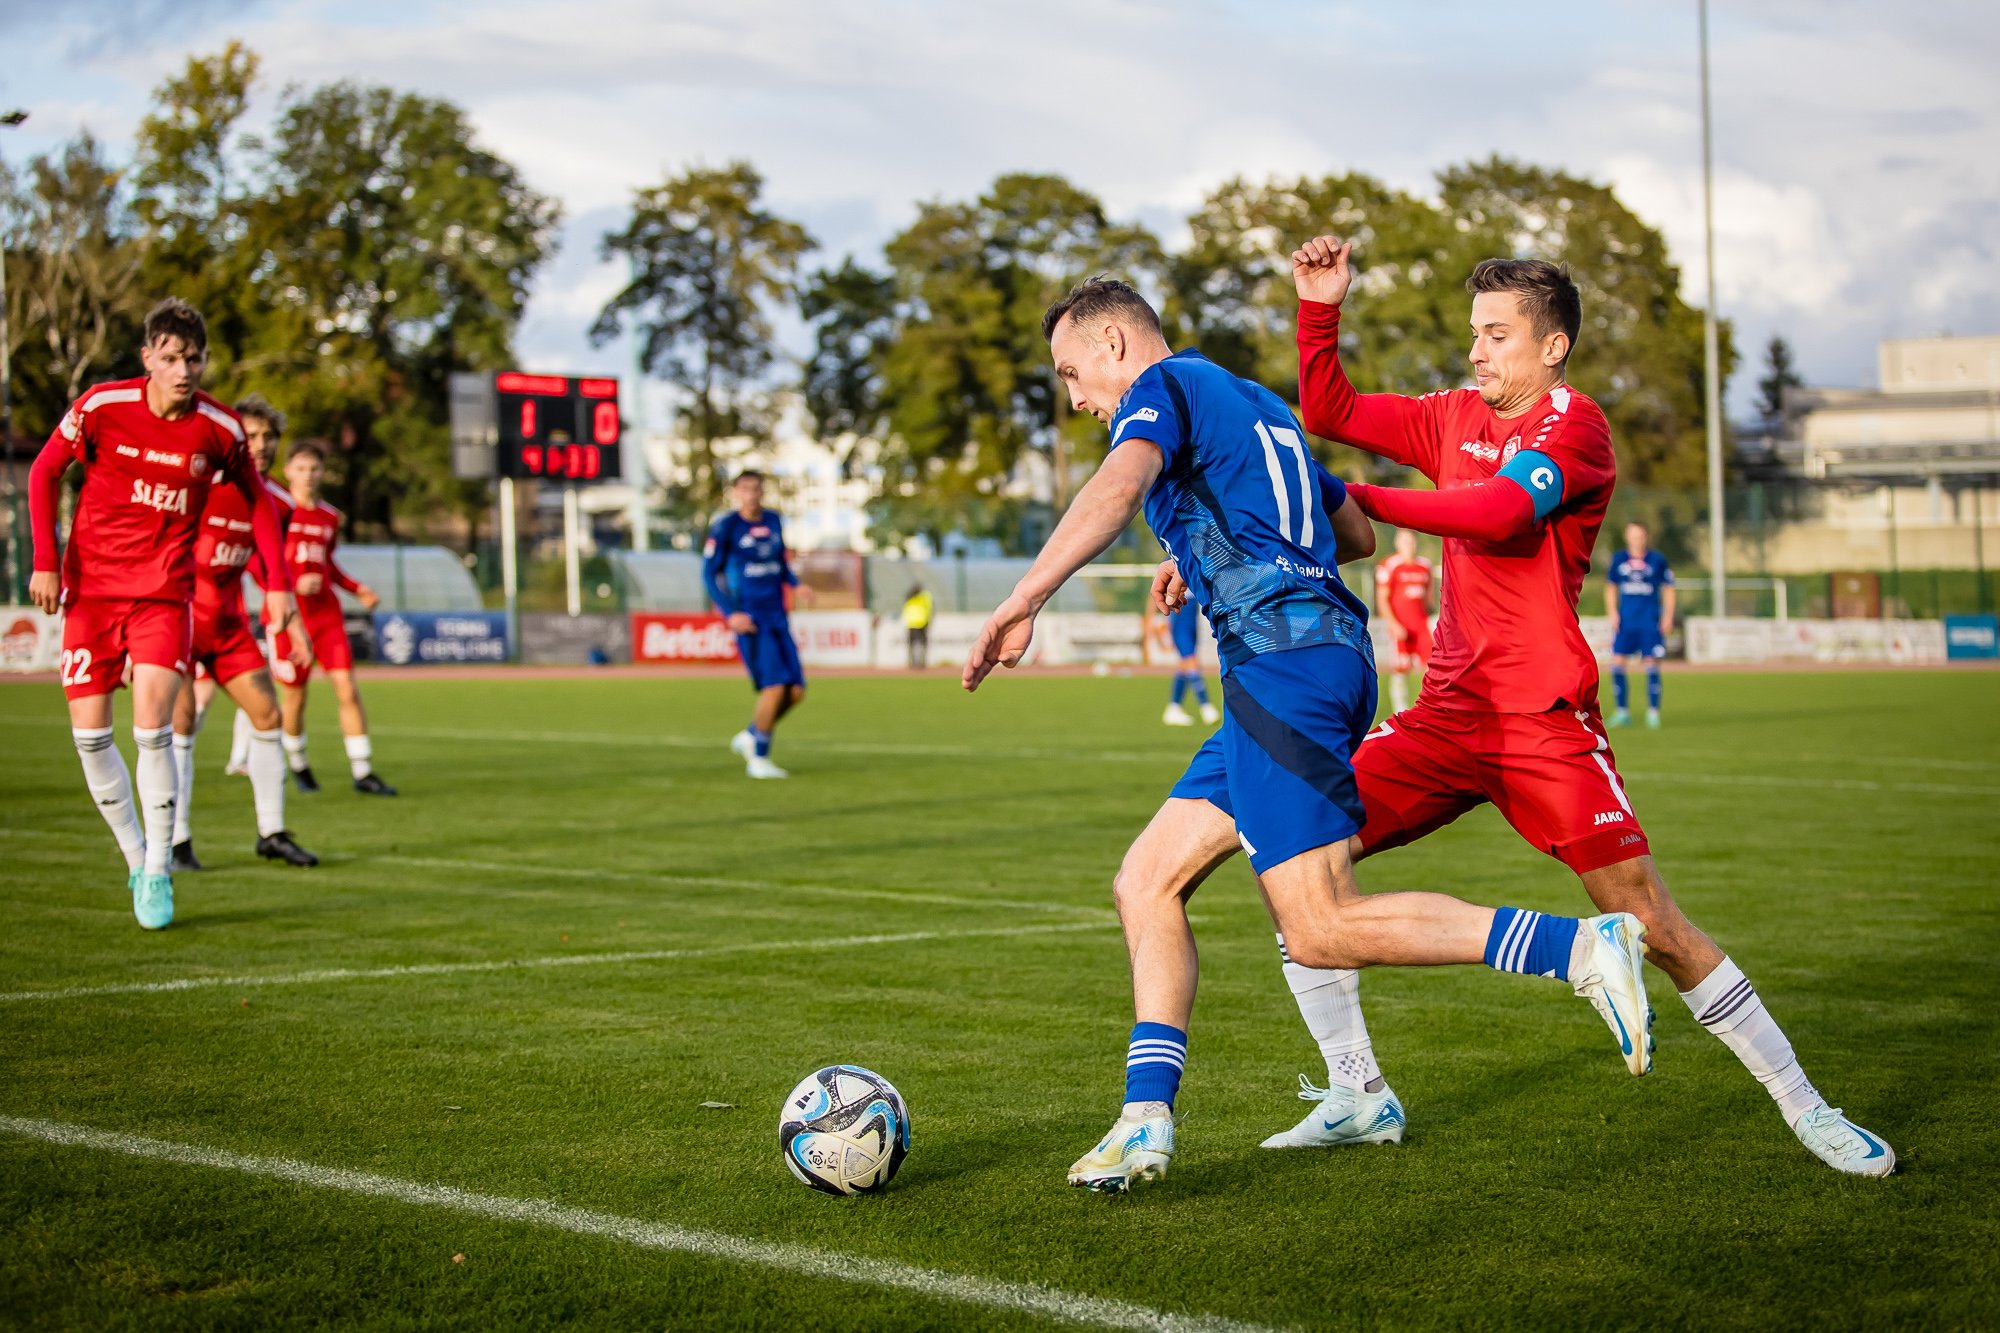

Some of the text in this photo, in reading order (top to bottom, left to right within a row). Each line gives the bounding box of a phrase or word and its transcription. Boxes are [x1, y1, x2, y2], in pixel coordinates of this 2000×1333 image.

[594, 401, 619, 445] 0
[1253, 419, 1314, 549] 17
[1530, 466, 1554, 490] C
[641, 622, 737, 659] Betclic
[62, 648, 92, 687] 22
[1594, 811, 1624, 826] JAKO
